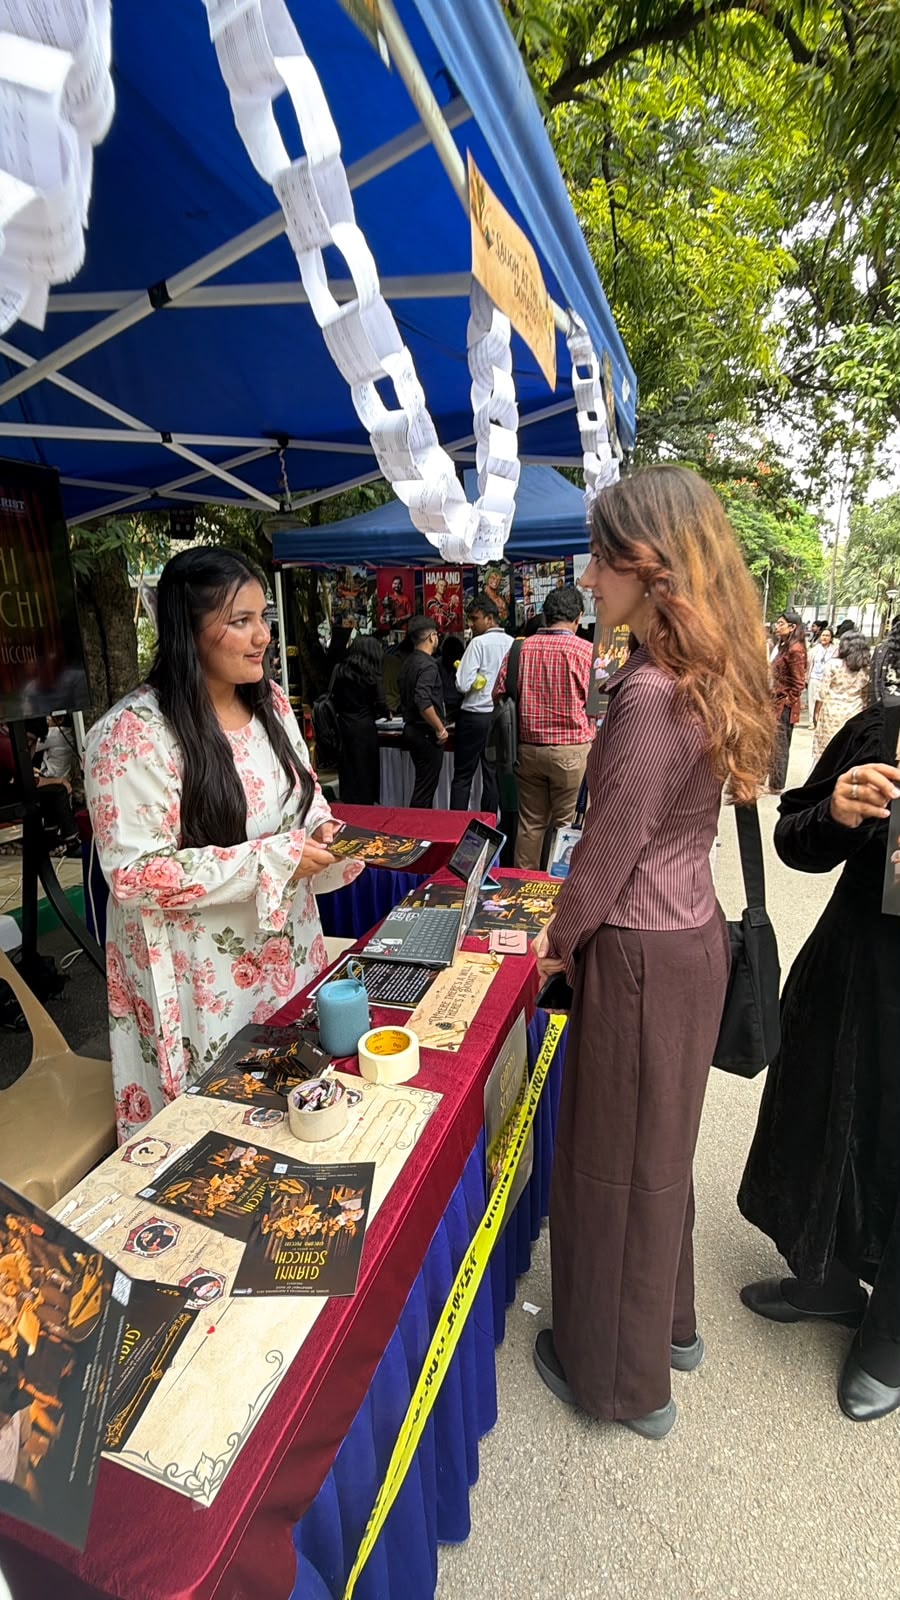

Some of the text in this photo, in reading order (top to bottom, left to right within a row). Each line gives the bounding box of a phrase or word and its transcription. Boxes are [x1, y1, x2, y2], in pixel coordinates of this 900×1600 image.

[123, 1210, 144, 1229] Cousin
[275, 1251, 327, 1265] SCHICCHI
[275, 1266, 319, 1280] GIANNI
